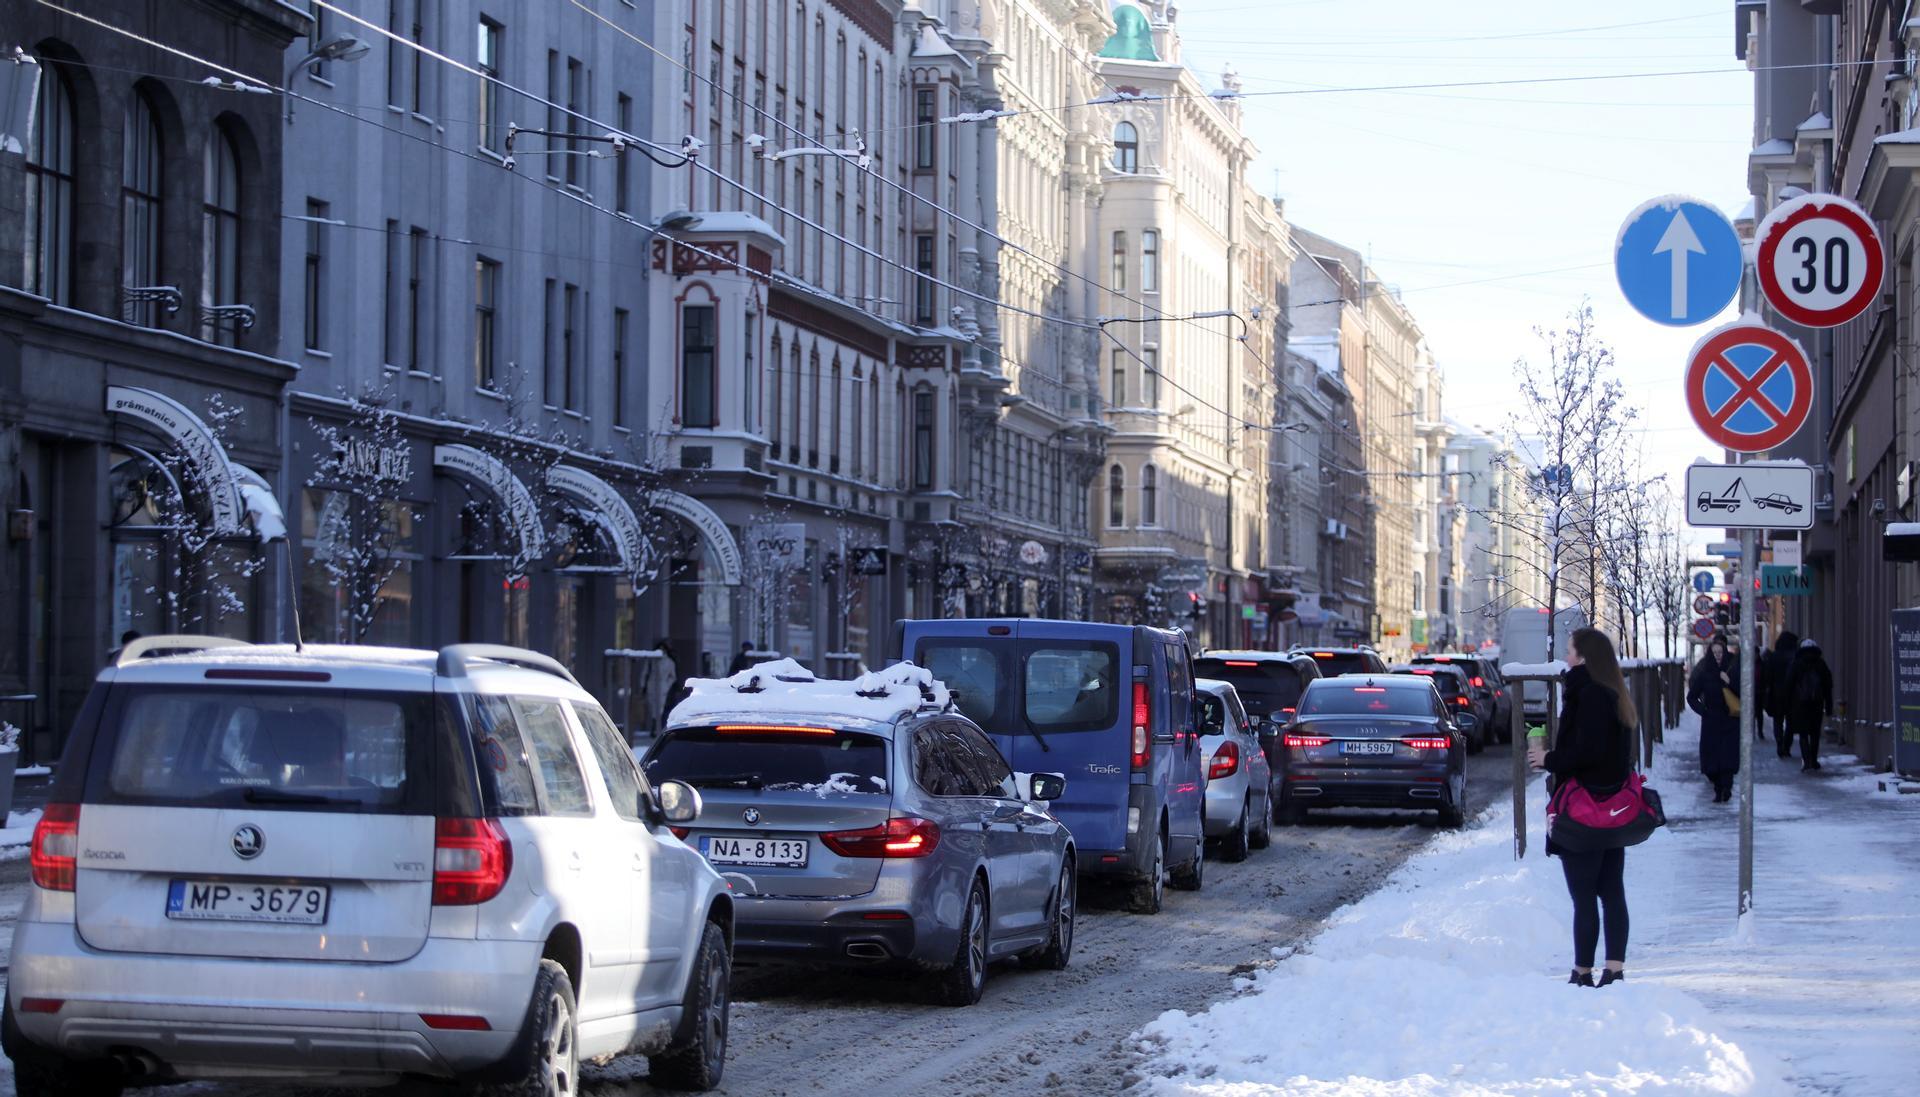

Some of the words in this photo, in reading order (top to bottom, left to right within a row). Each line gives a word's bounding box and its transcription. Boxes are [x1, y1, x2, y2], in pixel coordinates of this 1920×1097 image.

[1792, 236, 1849, 295] 30
[115, 398, 178, 430] grāmatnica
[1346, 743, 1392, 753] MH-5967
[1088, 763, 1121, 774] Trafic
[714, 839, 803, 860] NA-8133
[190, 884, 321, 914] MP-3679
